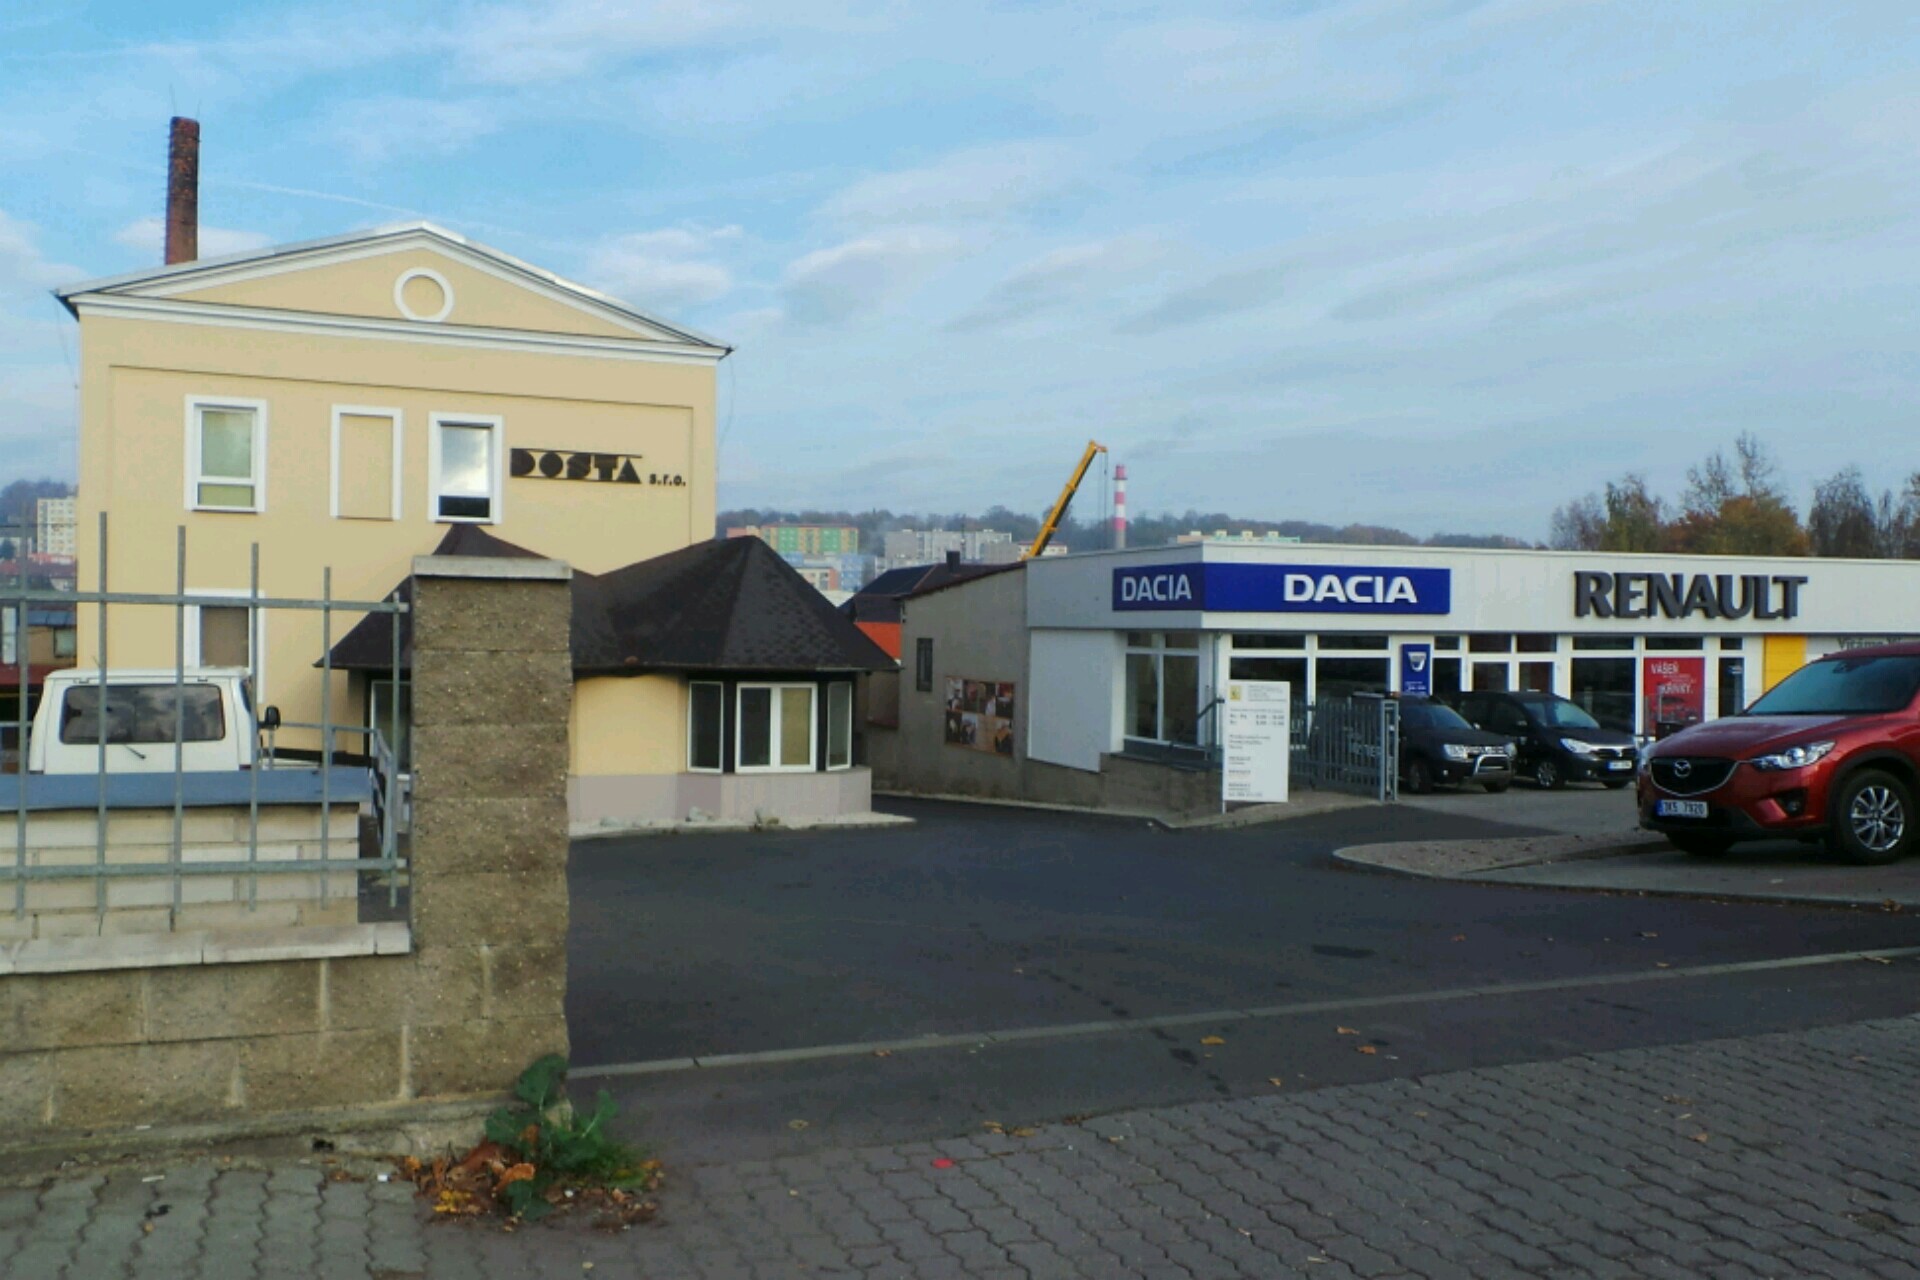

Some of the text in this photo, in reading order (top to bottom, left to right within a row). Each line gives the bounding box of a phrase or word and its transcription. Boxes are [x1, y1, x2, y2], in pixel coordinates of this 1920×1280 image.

[510, 448, 687, 487] DOSTA s.r.o.
[1121, 573, 1192, 601] DACIA
[1283, 573, 1418, 603] DACIA
[1574, 570, 1809, 620] RENAULT
